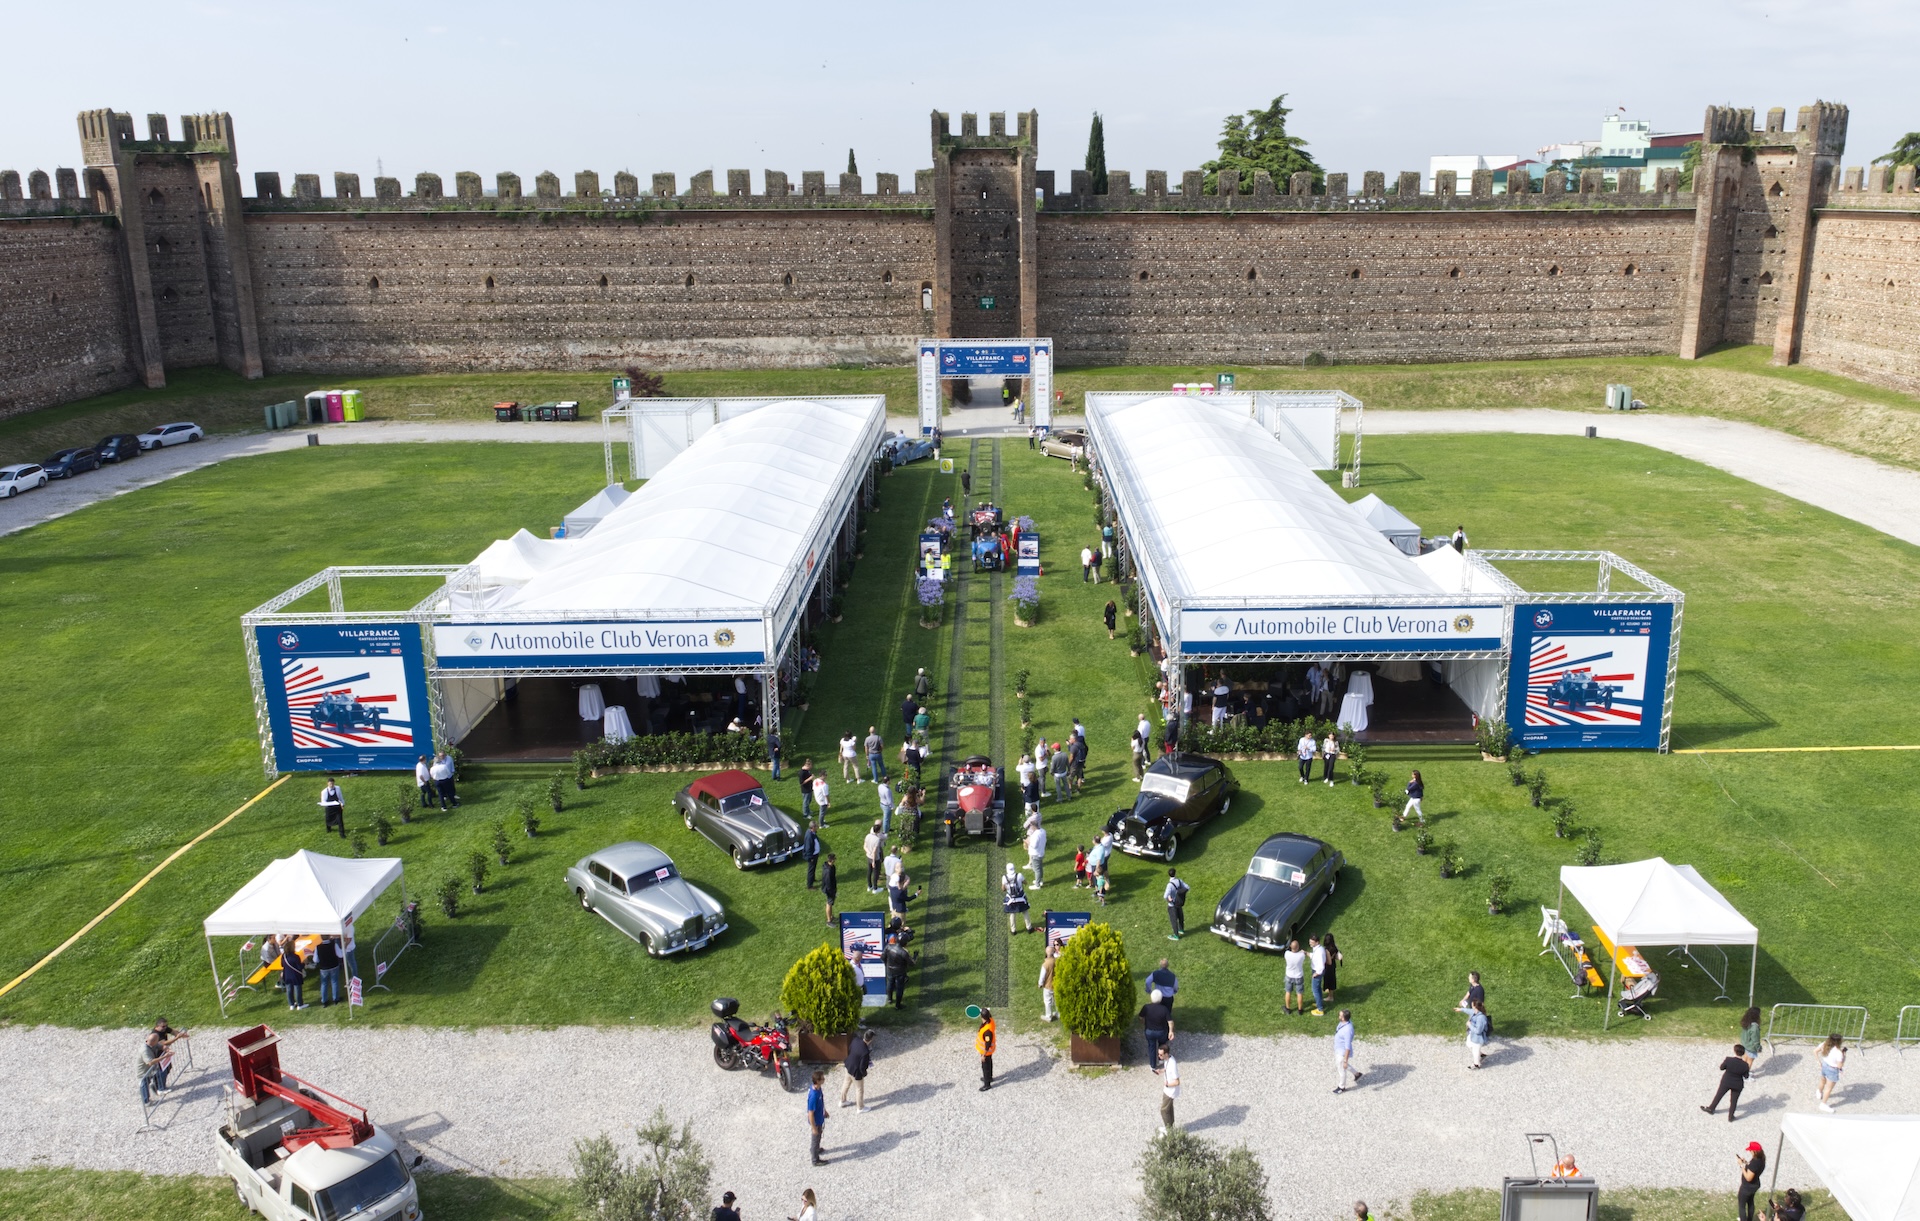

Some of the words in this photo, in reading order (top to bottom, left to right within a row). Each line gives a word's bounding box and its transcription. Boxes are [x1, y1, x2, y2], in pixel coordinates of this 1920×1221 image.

[338, 629, 400, 637] VILLAFRANCA
[1234, 616, 1337, 636] Automobile
[1343, 615, 1382, 634] Club
[1387, 616, 1448, 634] Verona
[490, 630, 595, 650] Automobile
[601, 629, 641, 649] Club
[645, 629, 709, 648] Verona
